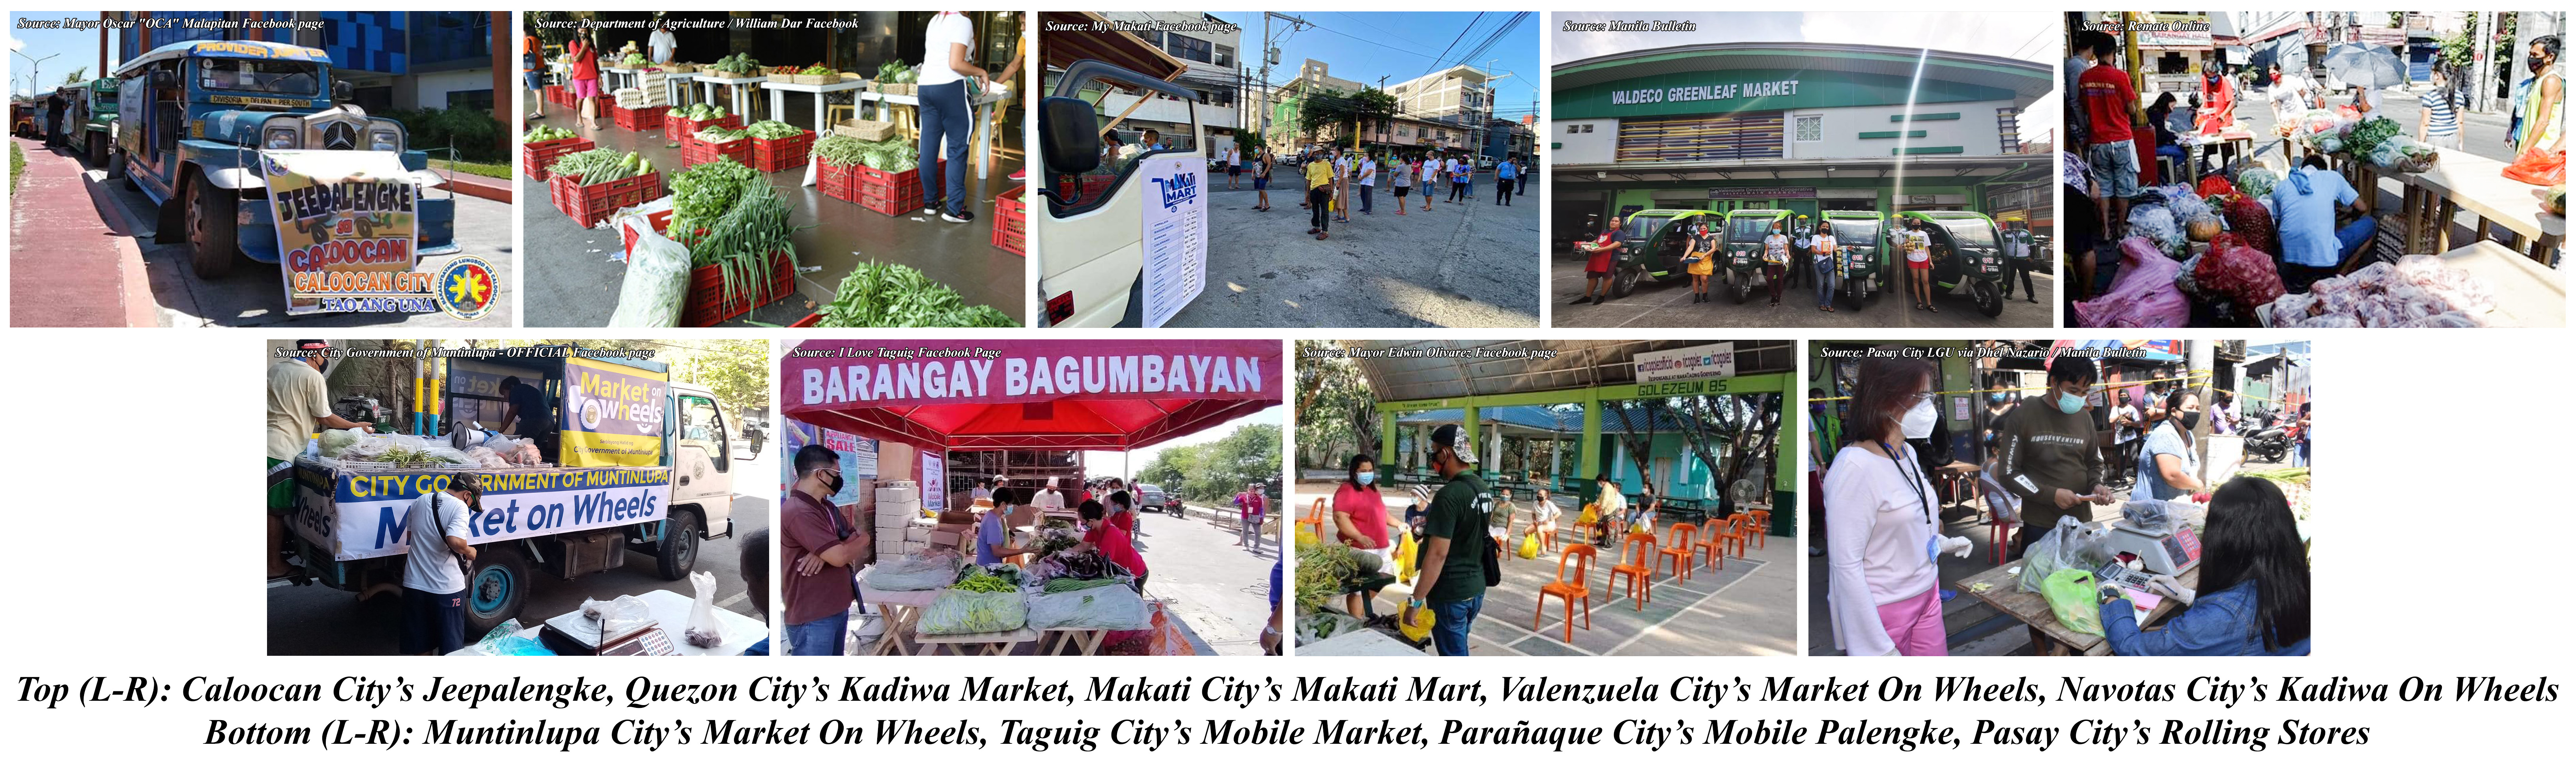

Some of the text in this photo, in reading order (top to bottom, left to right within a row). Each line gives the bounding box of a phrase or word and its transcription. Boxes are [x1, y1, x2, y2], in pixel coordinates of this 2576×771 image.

[197, 42, 267, 58] PROVIDER
[1612, 80, 1799, 105] VALDECO GREENLEAF MARKET
[1165, 172, 1196, 193] MAKATI
[277, 182, 413, 222] JEEPALENGKE
[1166, 185, 1196, 202] MART
[337, 219, 353, 234] sa
[1683, 352, 1702, 371] ricogolez
[1711, 349, 1732, 368] ricogolez
[581, 372, 661, 403] Market on
[803, 355, 1261, 405] BARANGAY BAGUMBAYAN
[1638, 381, 1704, 396] GOLEZEUM
[574, 447, 583, 455] City
[826, 439, 855, 452] SALE
[350, 469, 668, 497] CITY OF MUNTINLUPA
[375, 489, 657, 549] Mket on Wheels
[452, 598, 461, 607] 72
